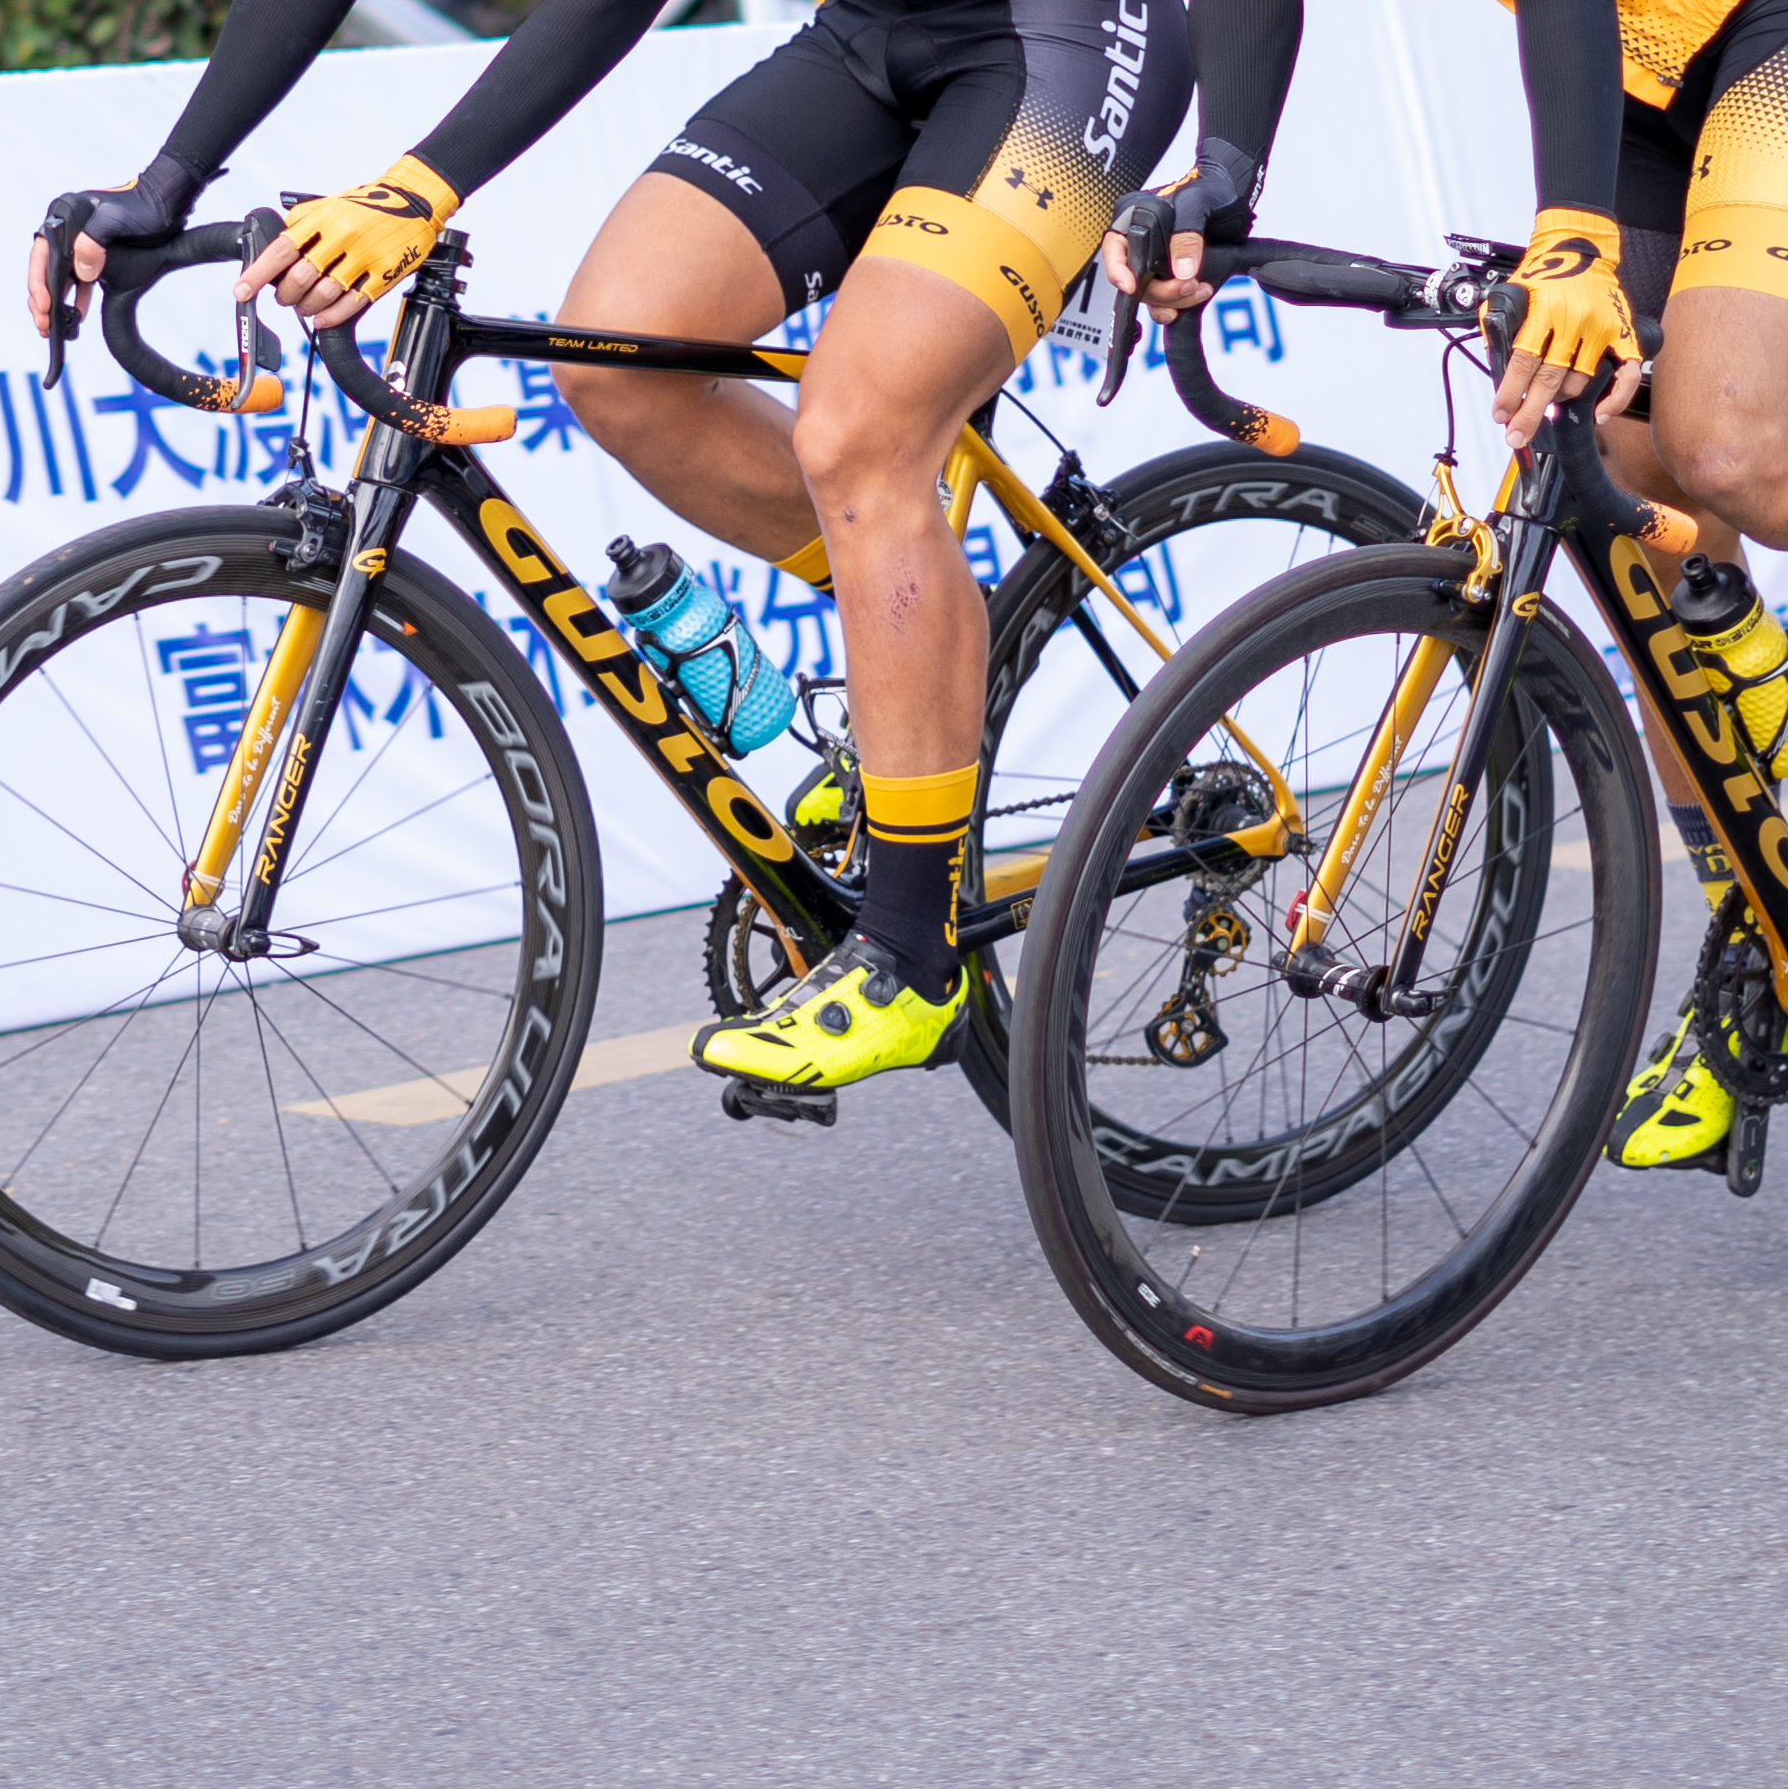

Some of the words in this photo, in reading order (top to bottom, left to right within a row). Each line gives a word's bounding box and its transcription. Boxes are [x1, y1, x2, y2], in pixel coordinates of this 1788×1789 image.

[382, 245, 422, 286] Santic
[999, 265, 1046, 340] GUSTO
[548, 336, 585, 349] TEAM
[588, 339, 639, 353] LIMITED
[479, 497, 794, 863] GUSTO
[255, 732, 313, 885] RANGER
[457, 680, 567, 985] BORA
[1411, 782, 1470, 941] RANGER
[317, 1004, 553, 1289] ULTRA
